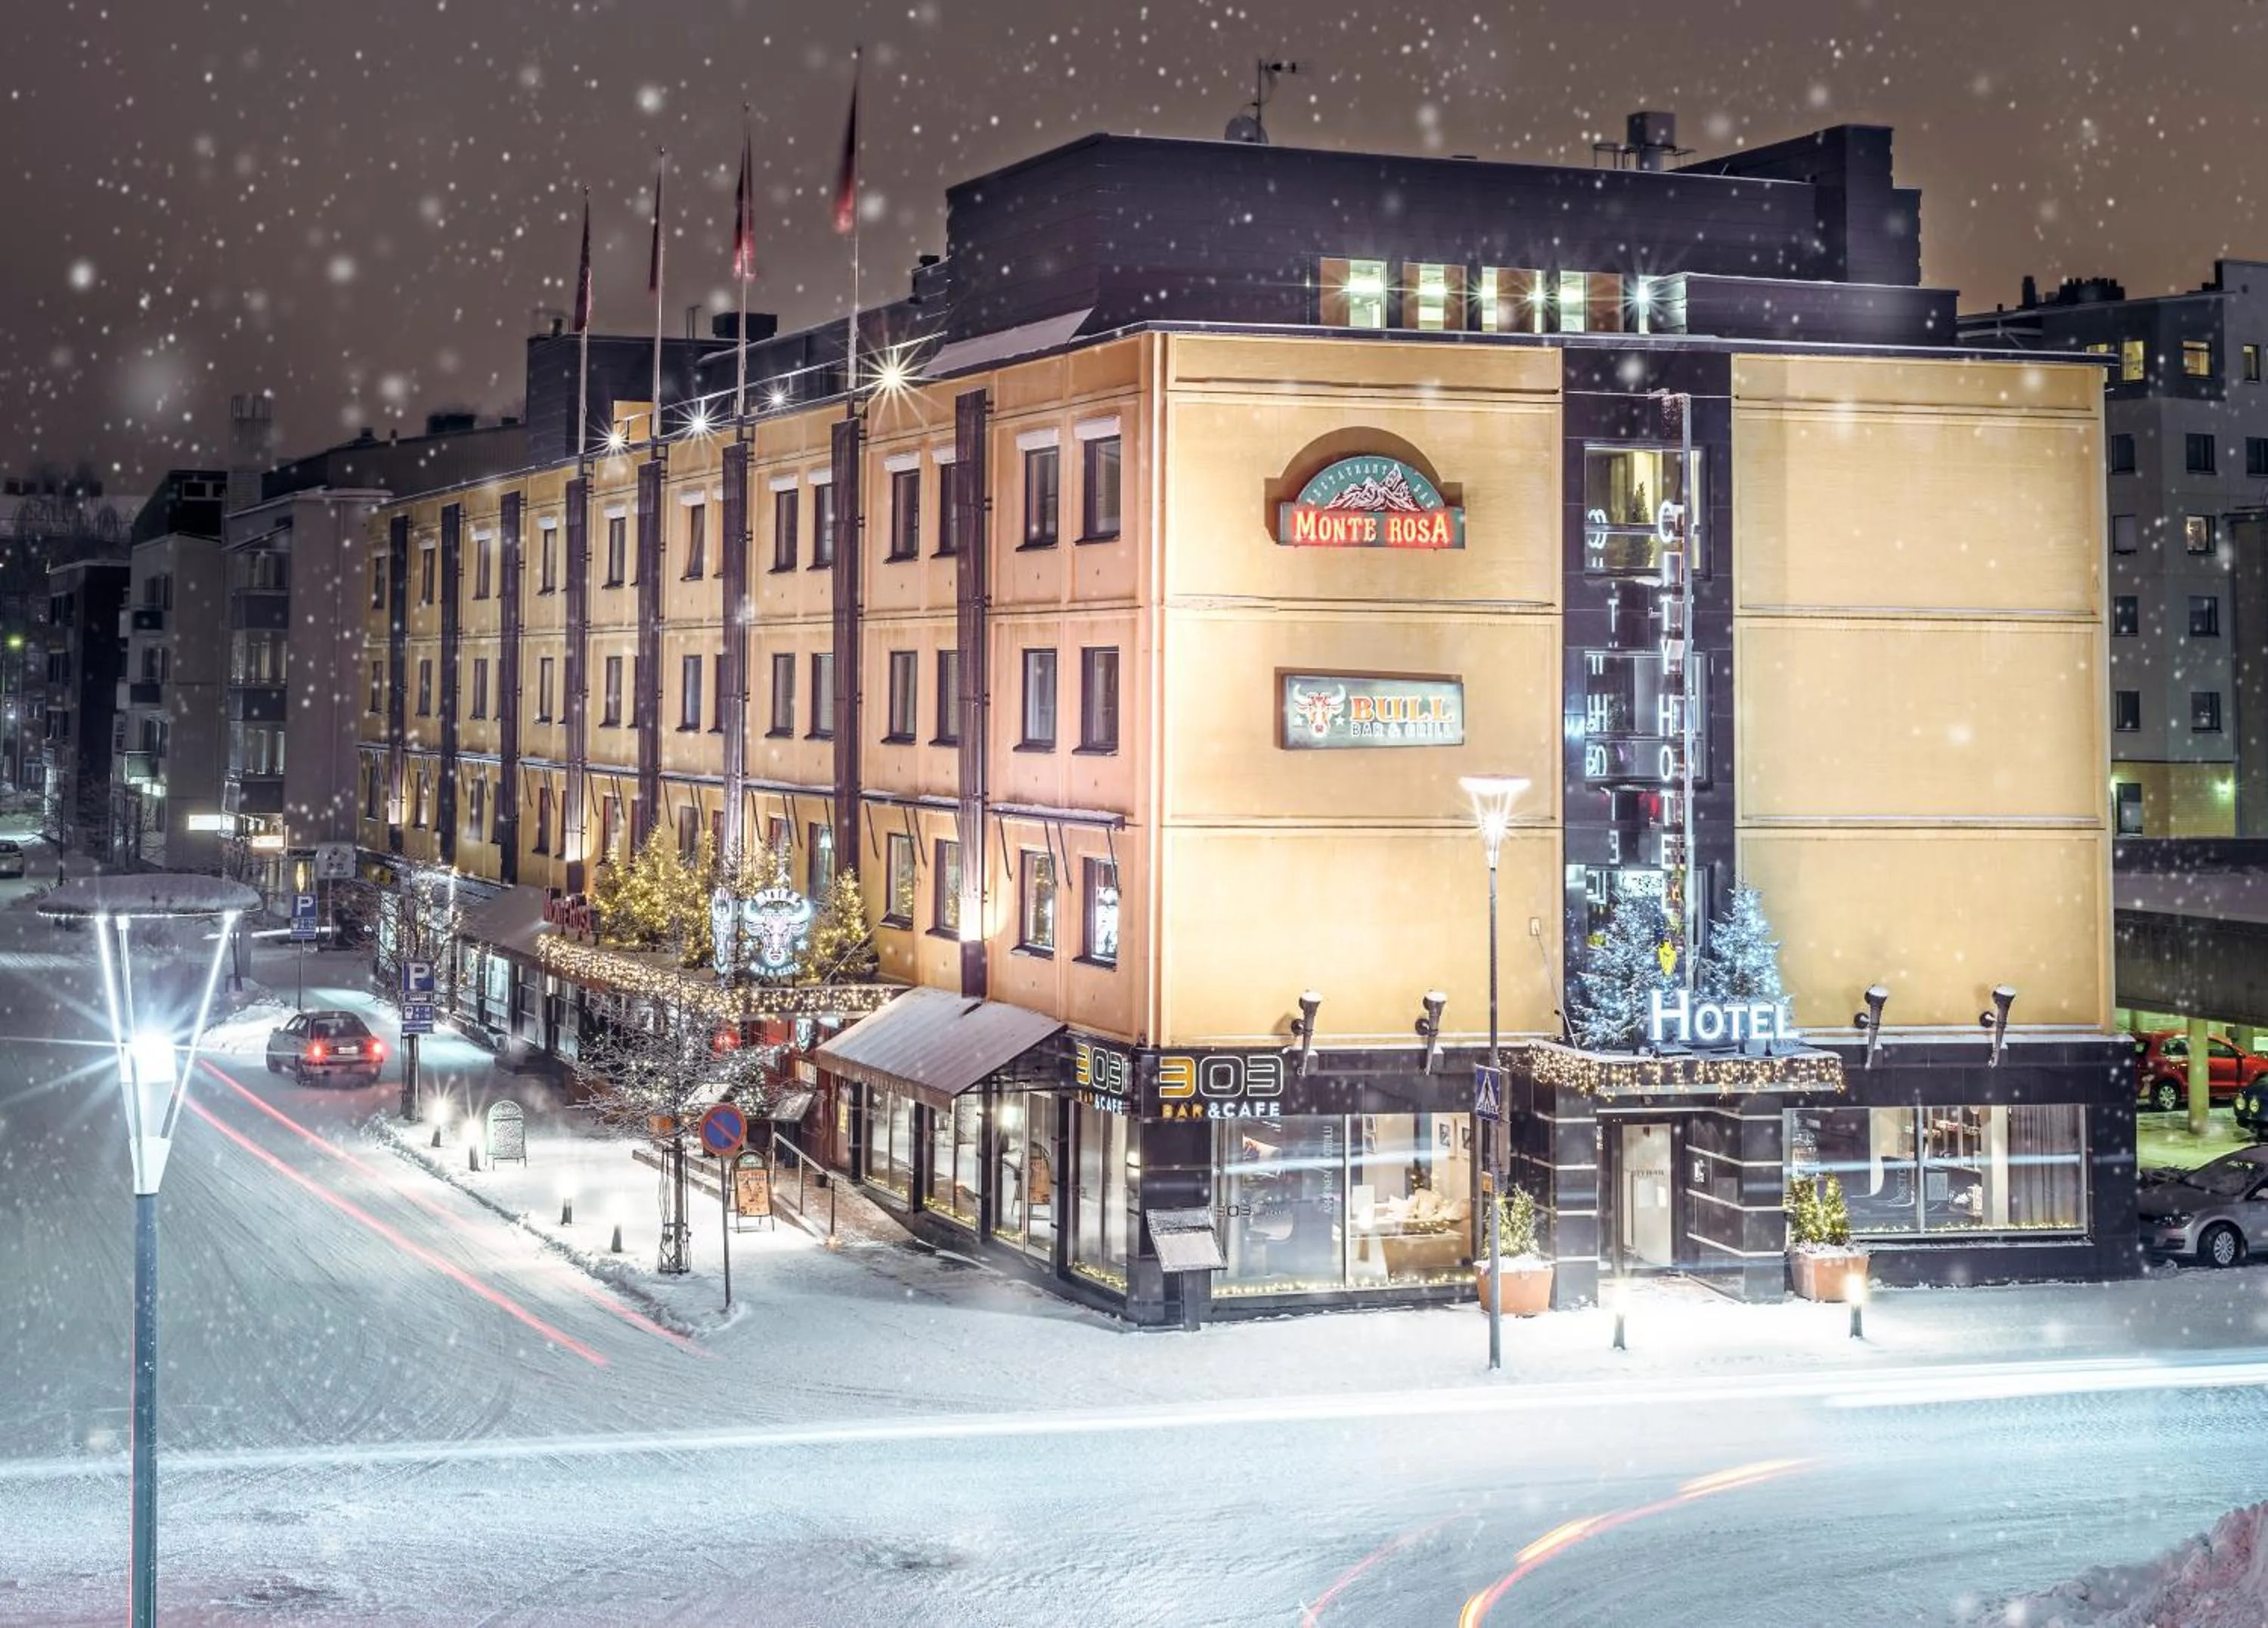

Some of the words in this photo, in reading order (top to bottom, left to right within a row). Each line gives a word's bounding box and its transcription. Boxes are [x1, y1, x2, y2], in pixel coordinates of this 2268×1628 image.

[1294, 510, 1377, 542] MONTE
[1388, 512, 1450, 543] ROSA
[1349, 695, 1455, 723] BULL
[1351, 723, 1383, 738] BAR
[296, 896, 314, 916] P
[409, 962, 430, 989] P
[1650, 988, 1799, 1041] HOTEL
[1077, 1043, 1124, 1095] 303
[1159, 1056, 1283, 1098] 303
[1161, 1103, 1204, 1119] BAR
